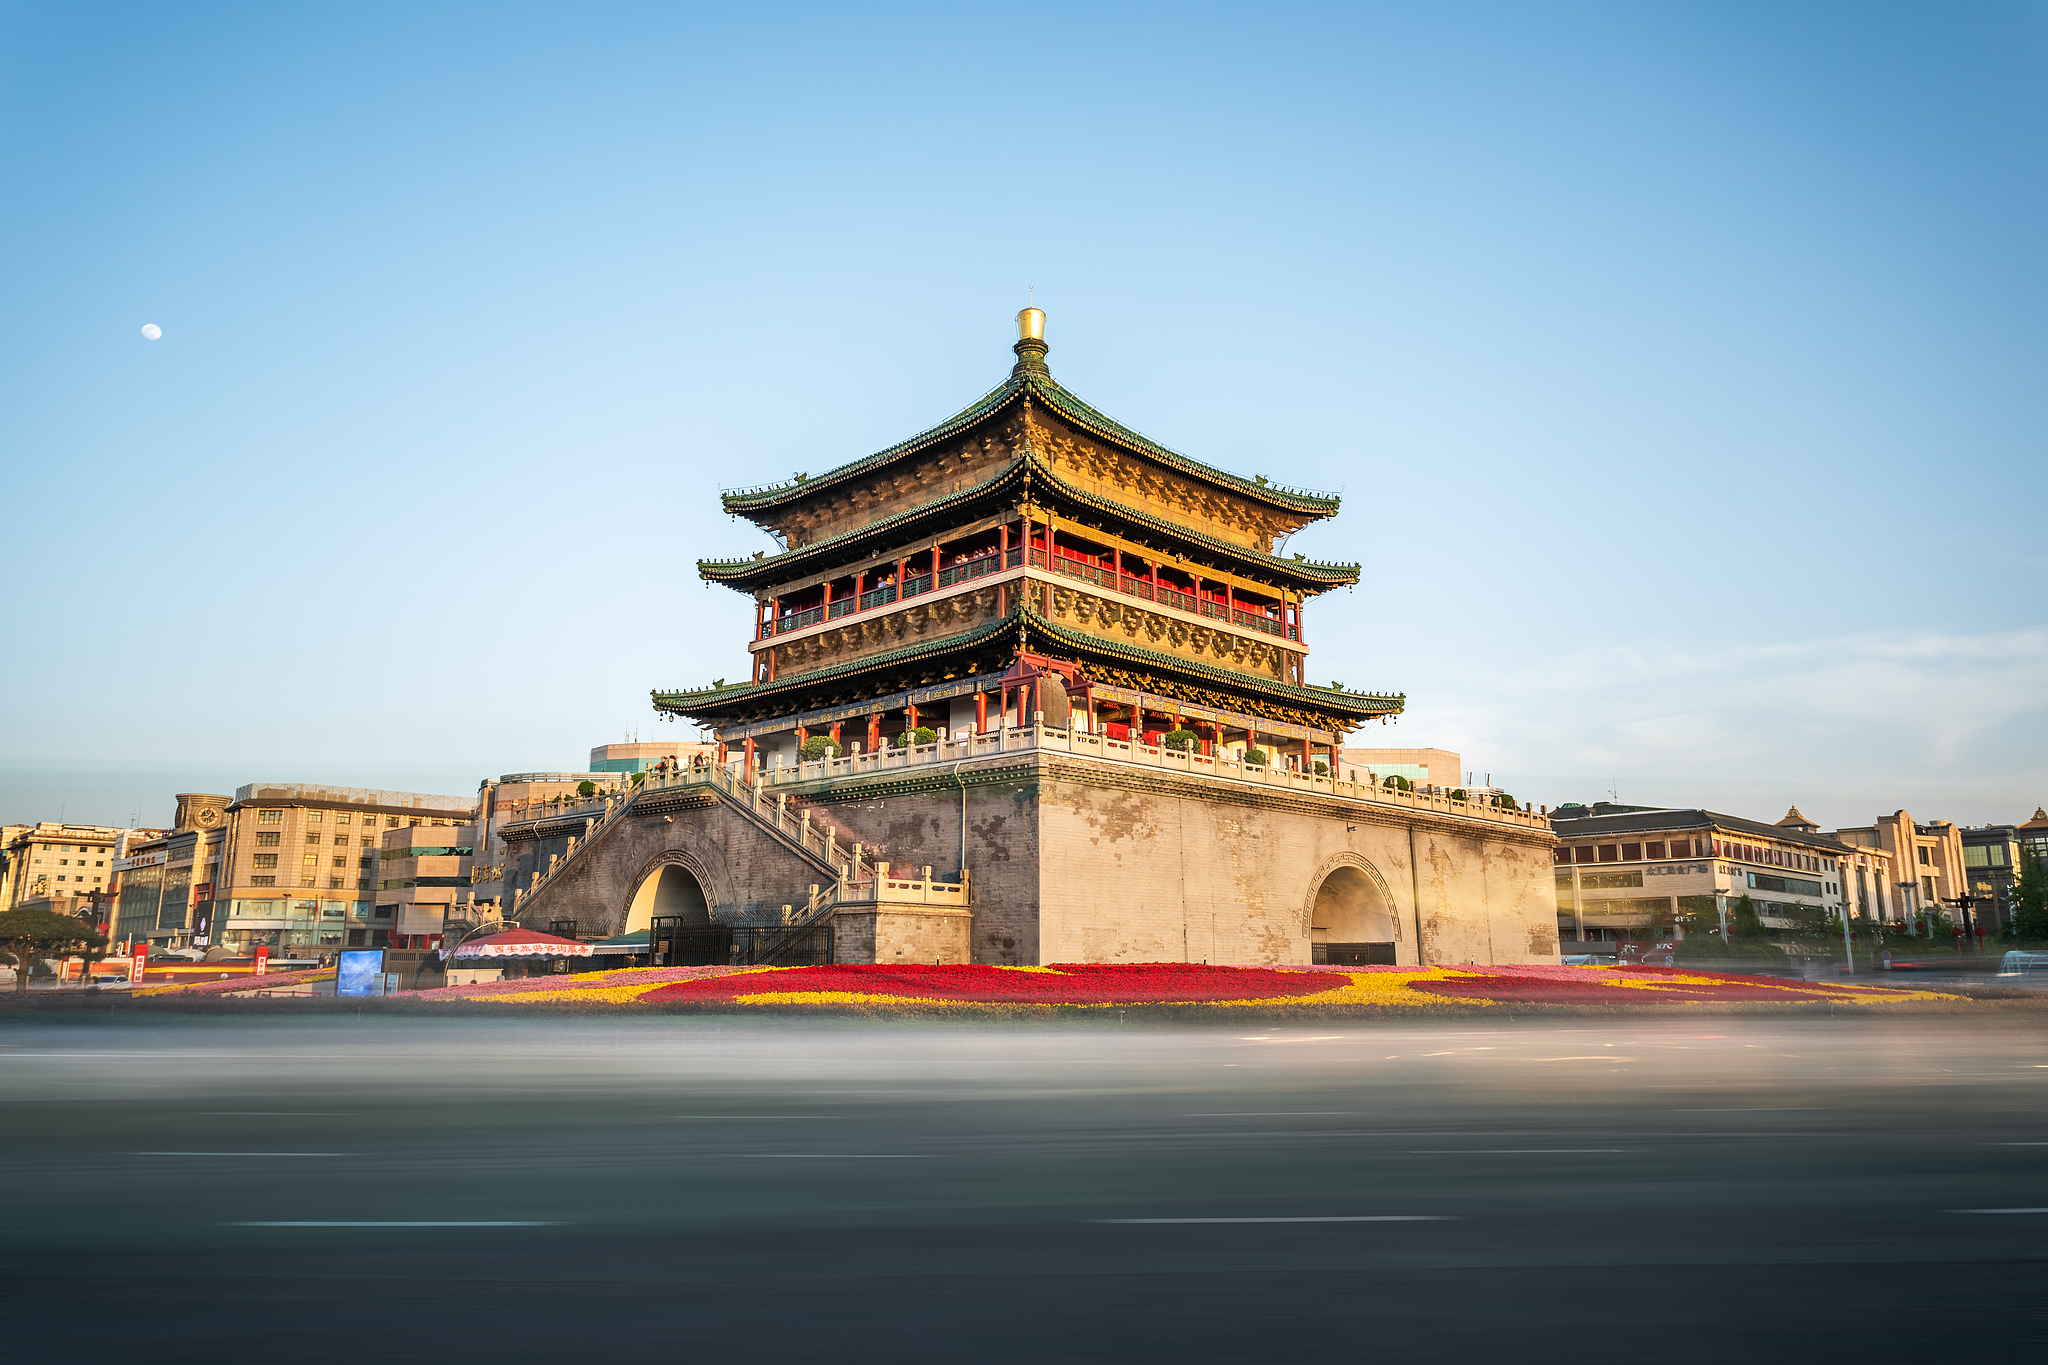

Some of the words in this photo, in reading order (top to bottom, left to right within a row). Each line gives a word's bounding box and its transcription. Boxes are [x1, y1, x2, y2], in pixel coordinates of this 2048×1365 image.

[471, 862, 505, 884] 元商城
[492, 944, 589, 954] 西安旅游咨询服务
